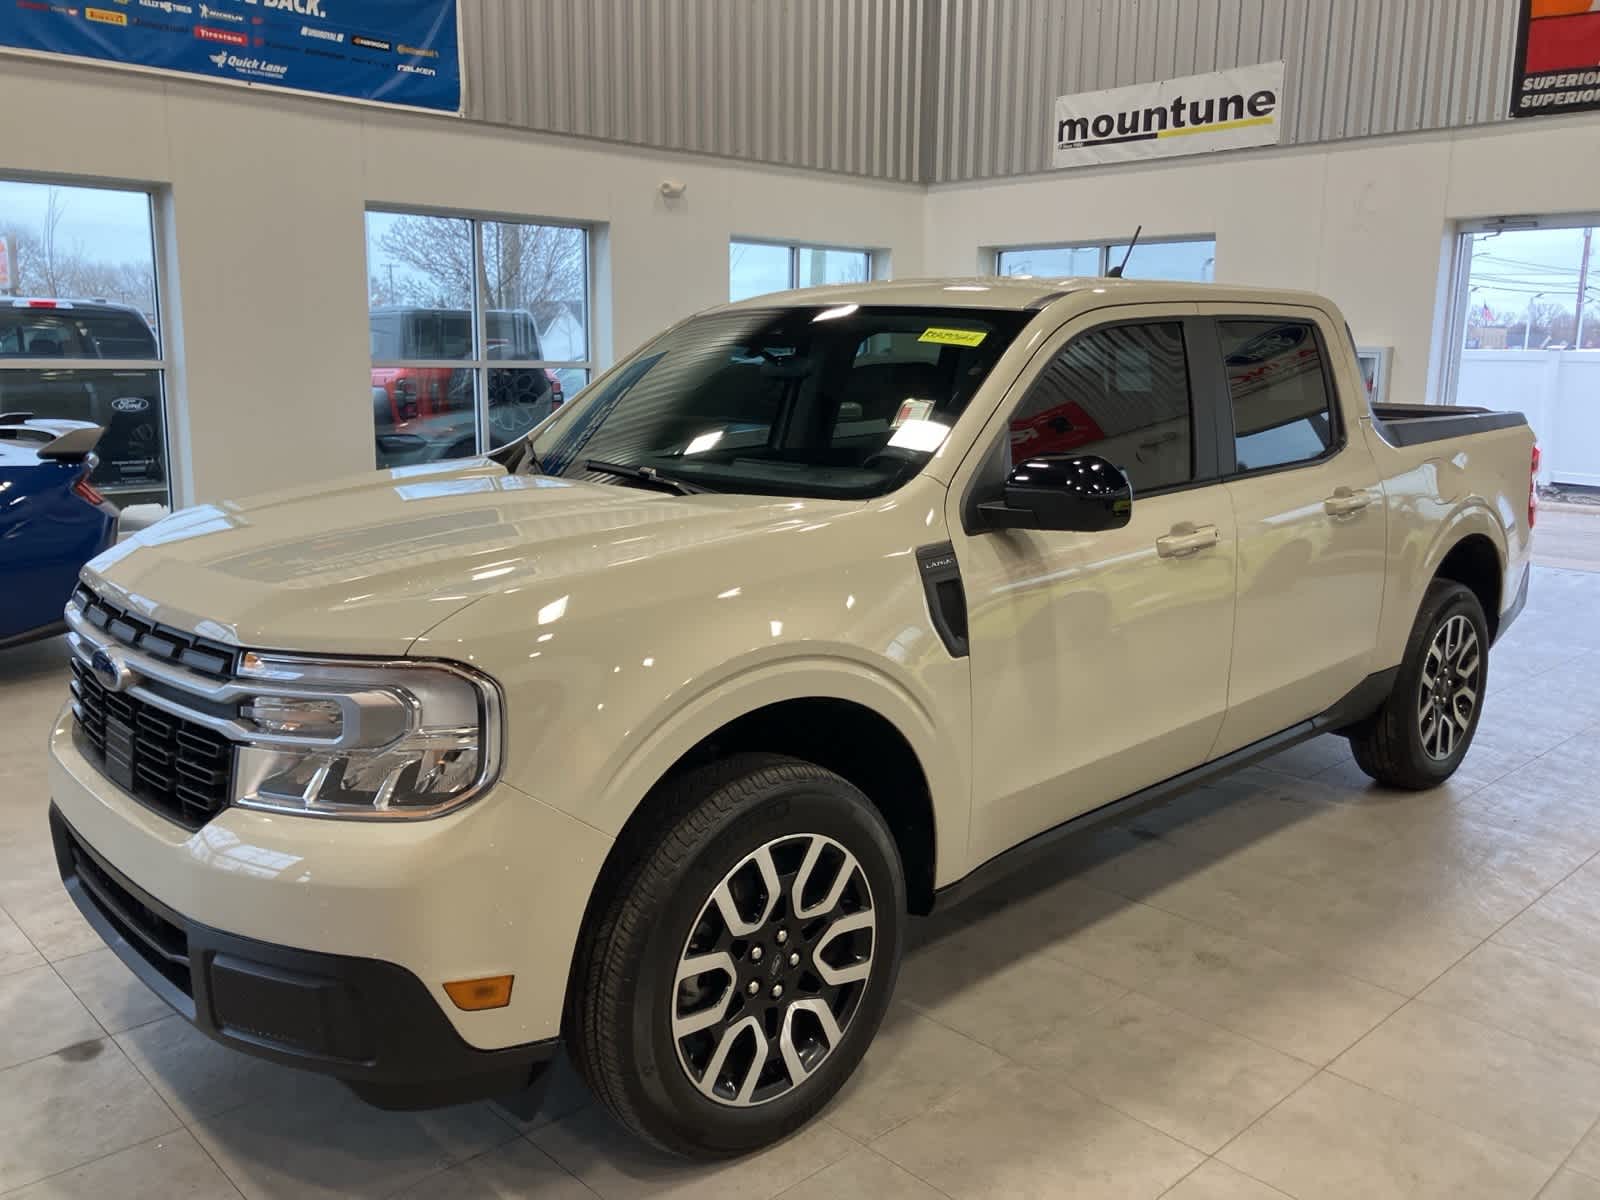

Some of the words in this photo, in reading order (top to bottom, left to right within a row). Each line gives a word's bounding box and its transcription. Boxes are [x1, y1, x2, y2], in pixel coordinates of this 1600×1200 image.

[227, 55, 259, 69] Quick
[260, 60, 288, 74] Lane
[1057, 90, 1276, 142] mountune
